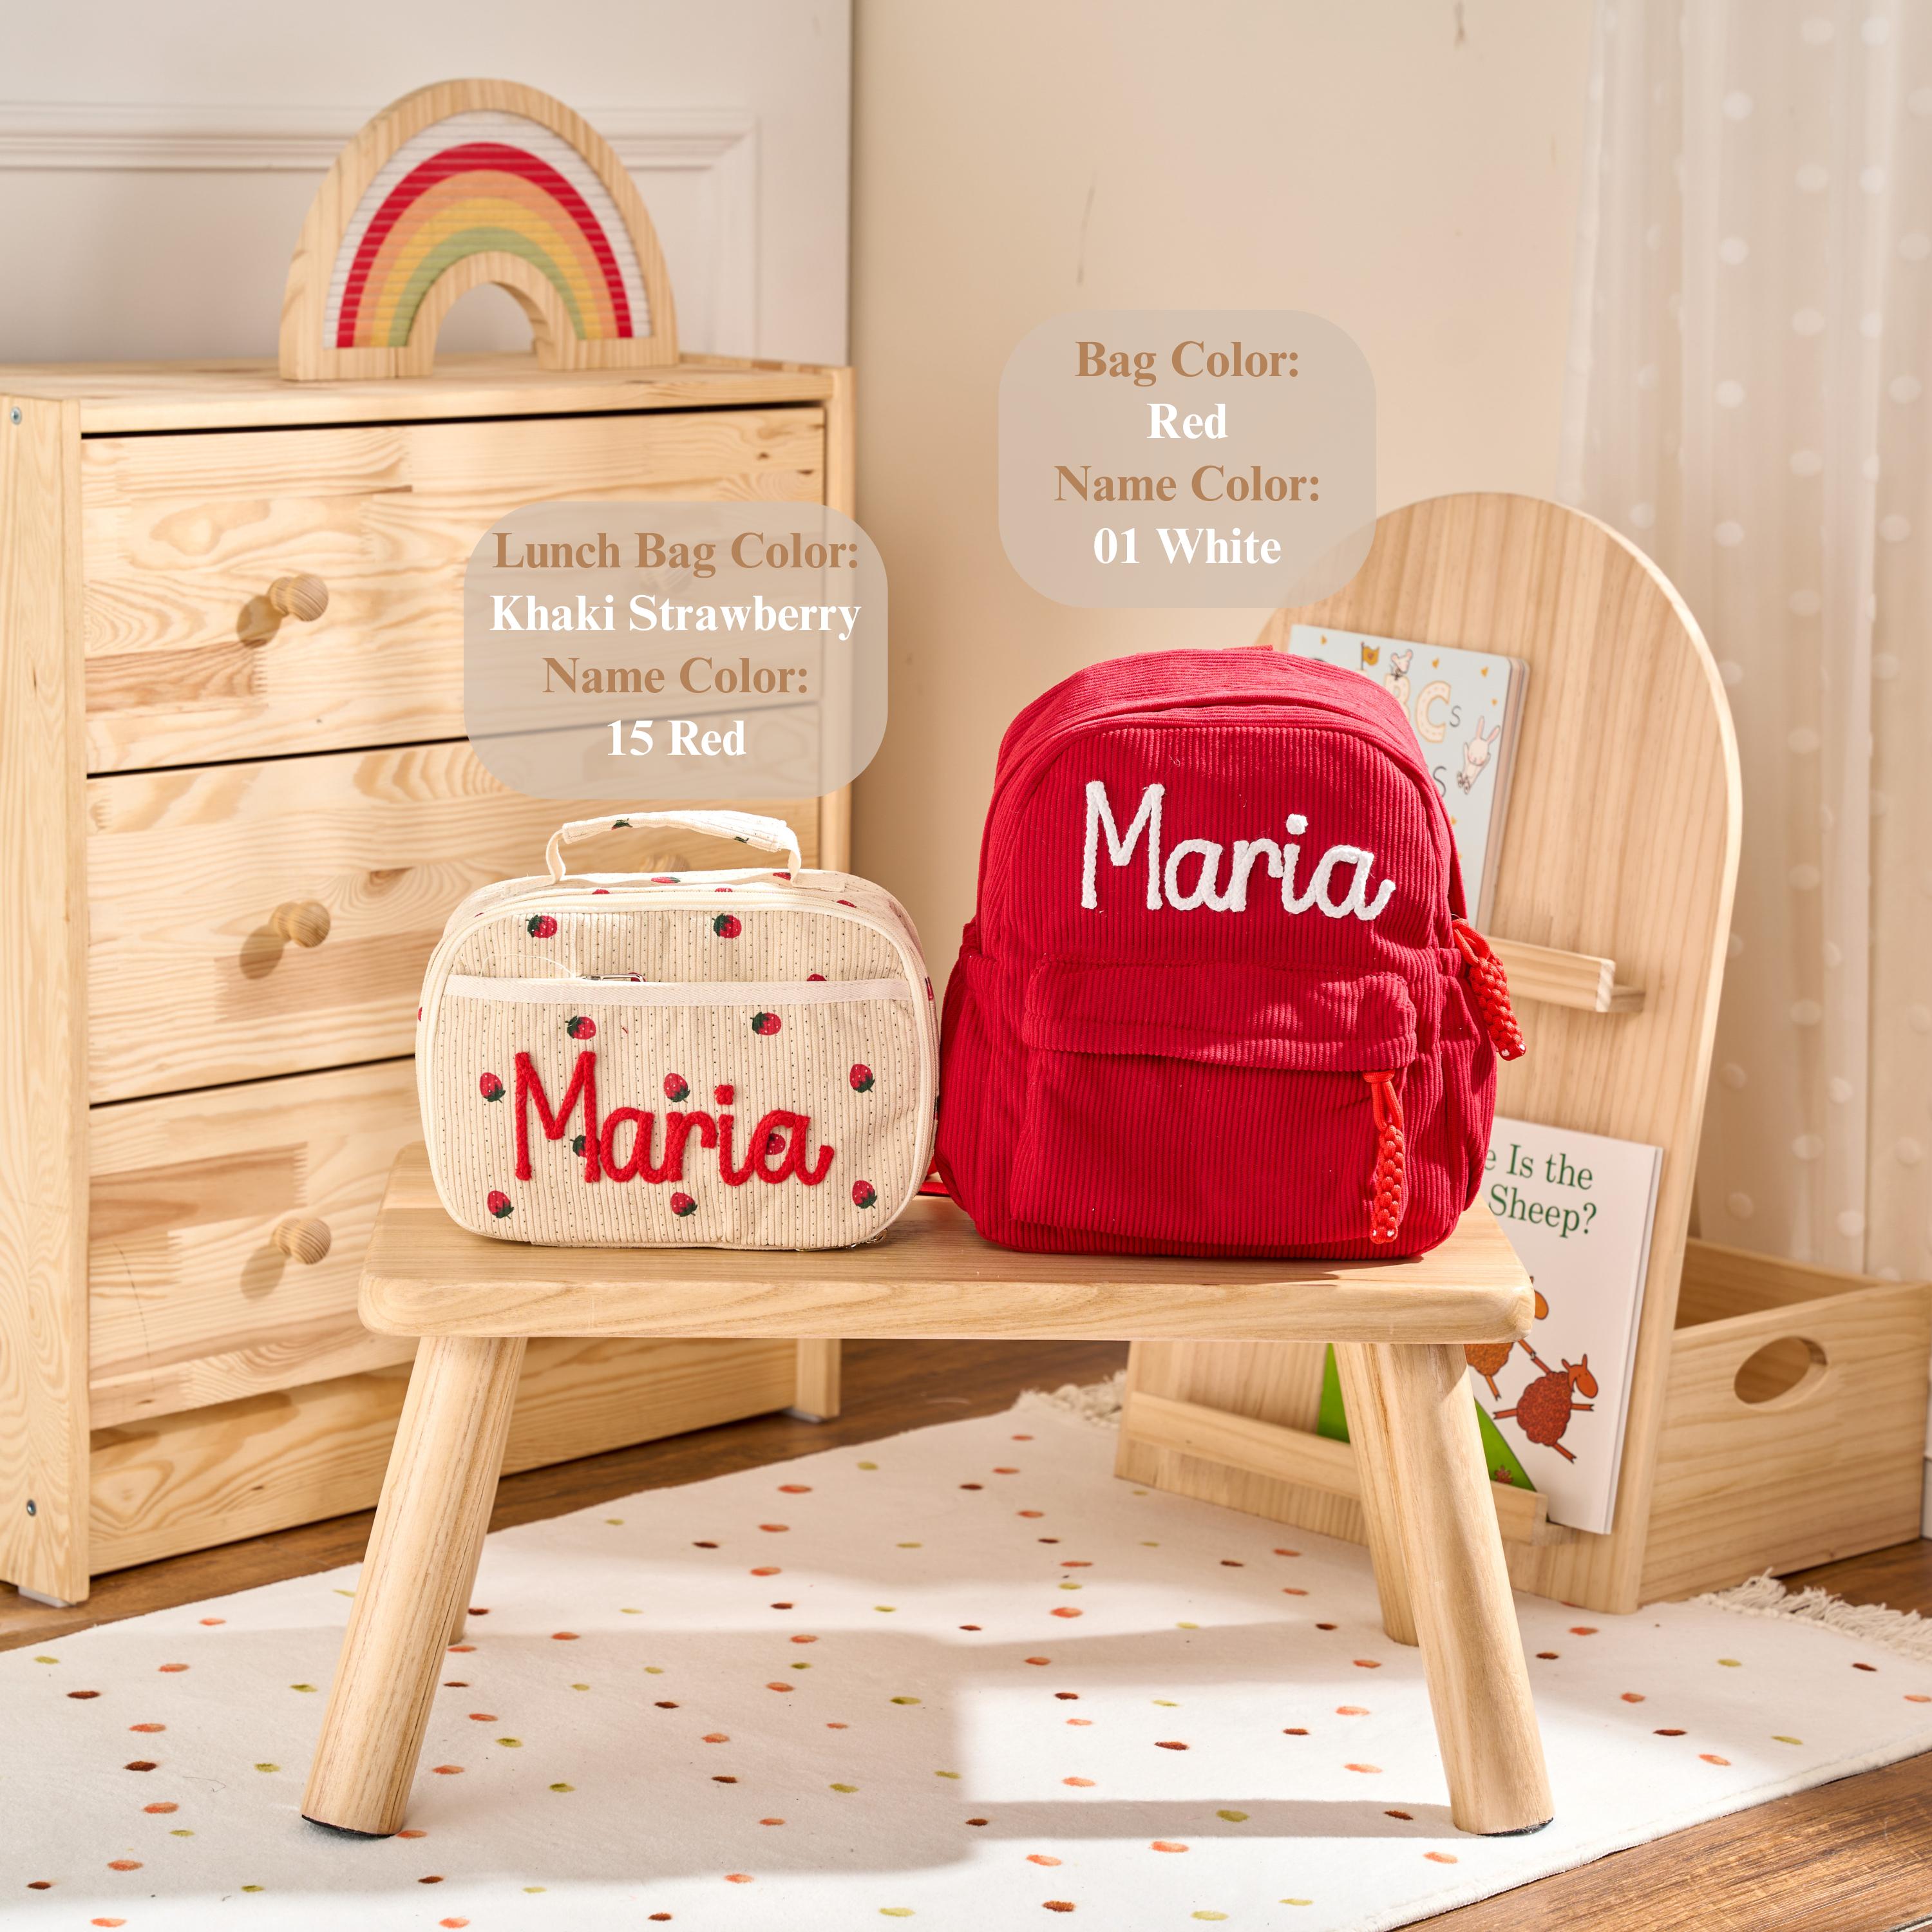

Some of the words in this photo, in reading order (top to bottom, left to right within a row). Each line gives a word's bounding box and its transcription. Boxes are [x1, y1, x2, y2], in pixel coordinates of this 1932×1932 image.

[1081, 781, 1396, 921] Maria
[515, 1051, 835, 1186] Maria
[1488, 1183, 1597, 1239] Sheep?
[1506, 1143, 1534, 1179] Is
[1545, 1152, 1593, 1190] the
